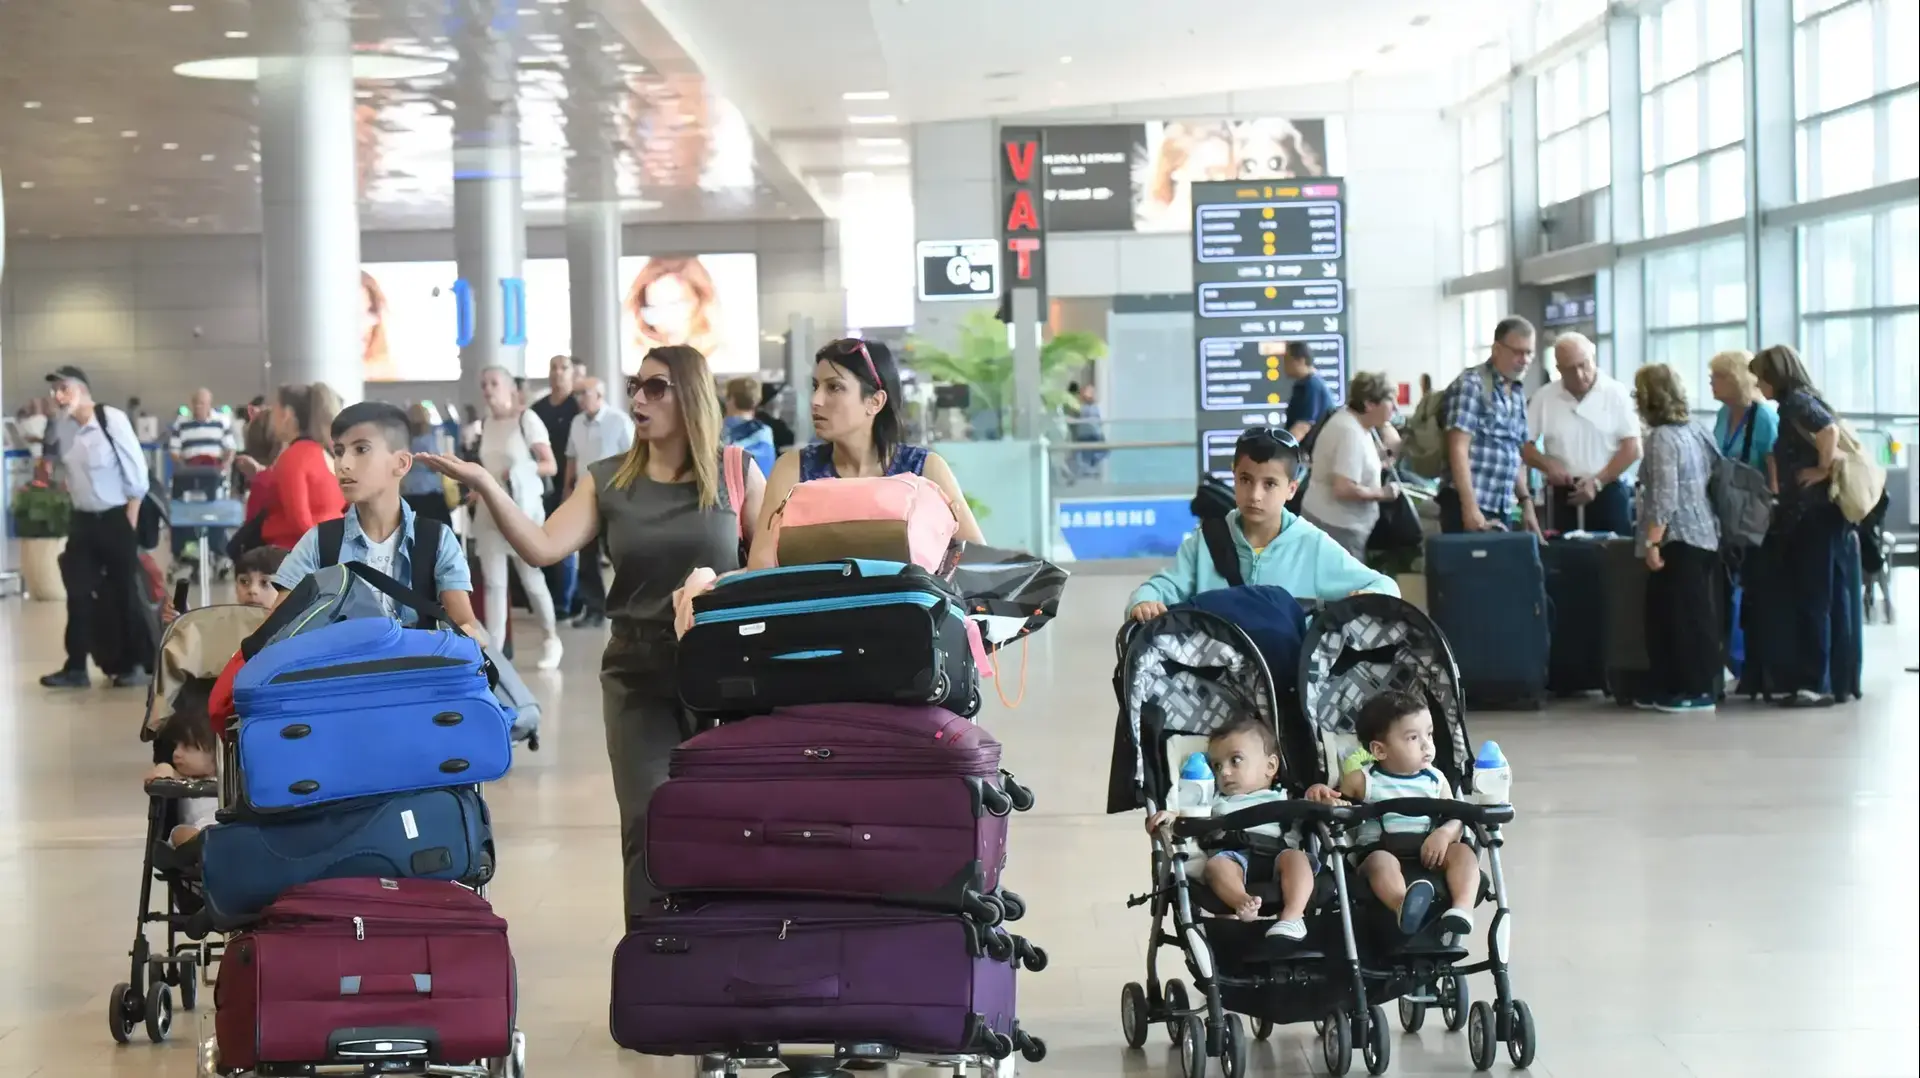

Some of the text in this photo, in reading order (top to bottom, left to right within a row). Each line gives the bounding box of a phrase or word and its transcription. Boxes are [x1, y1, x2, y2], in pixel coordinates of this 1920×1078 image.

[1005, 141, 1040, 280] VAT
[946, 256, 971, 285] G
[1060, 508, 1156, 528] SAMSUNG
